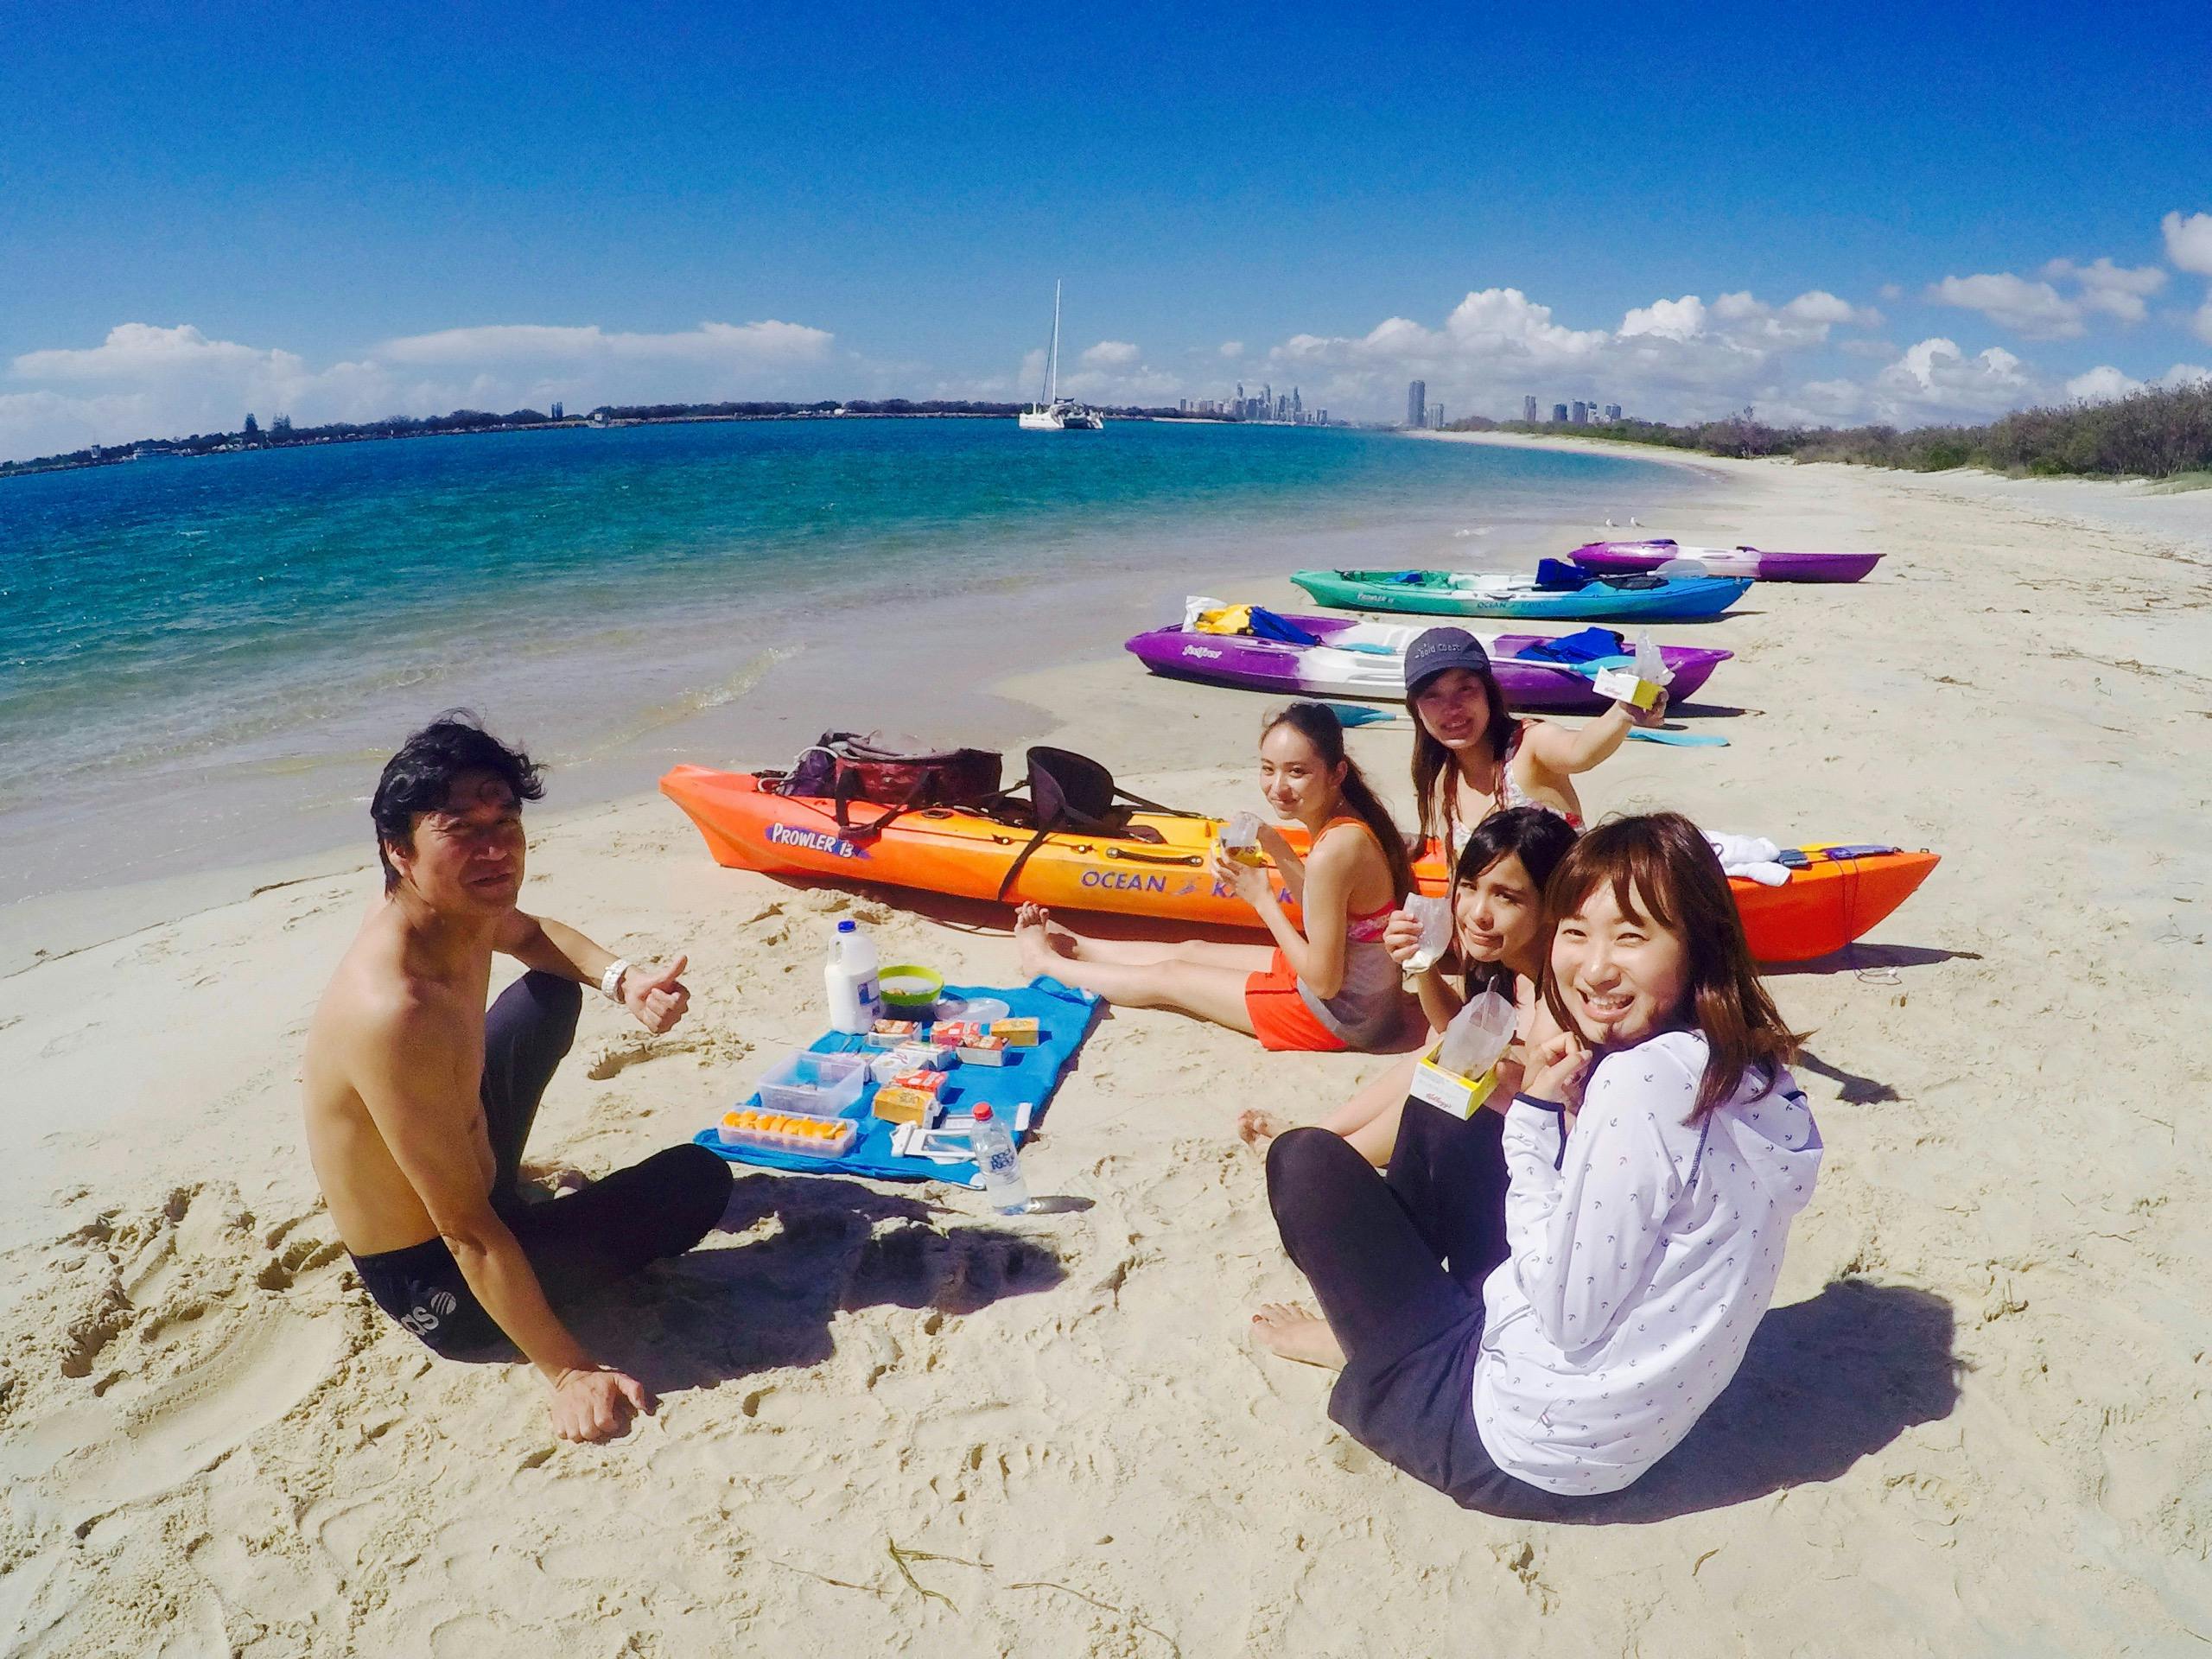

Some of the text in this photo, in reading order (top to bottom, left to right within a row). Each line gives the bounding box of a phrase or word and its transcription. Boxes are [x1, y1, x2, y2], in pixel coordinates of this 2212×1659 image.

[772, 822, 855, 858] PROWLER 13
[1081, 870, 1166, 893] OCEAN
